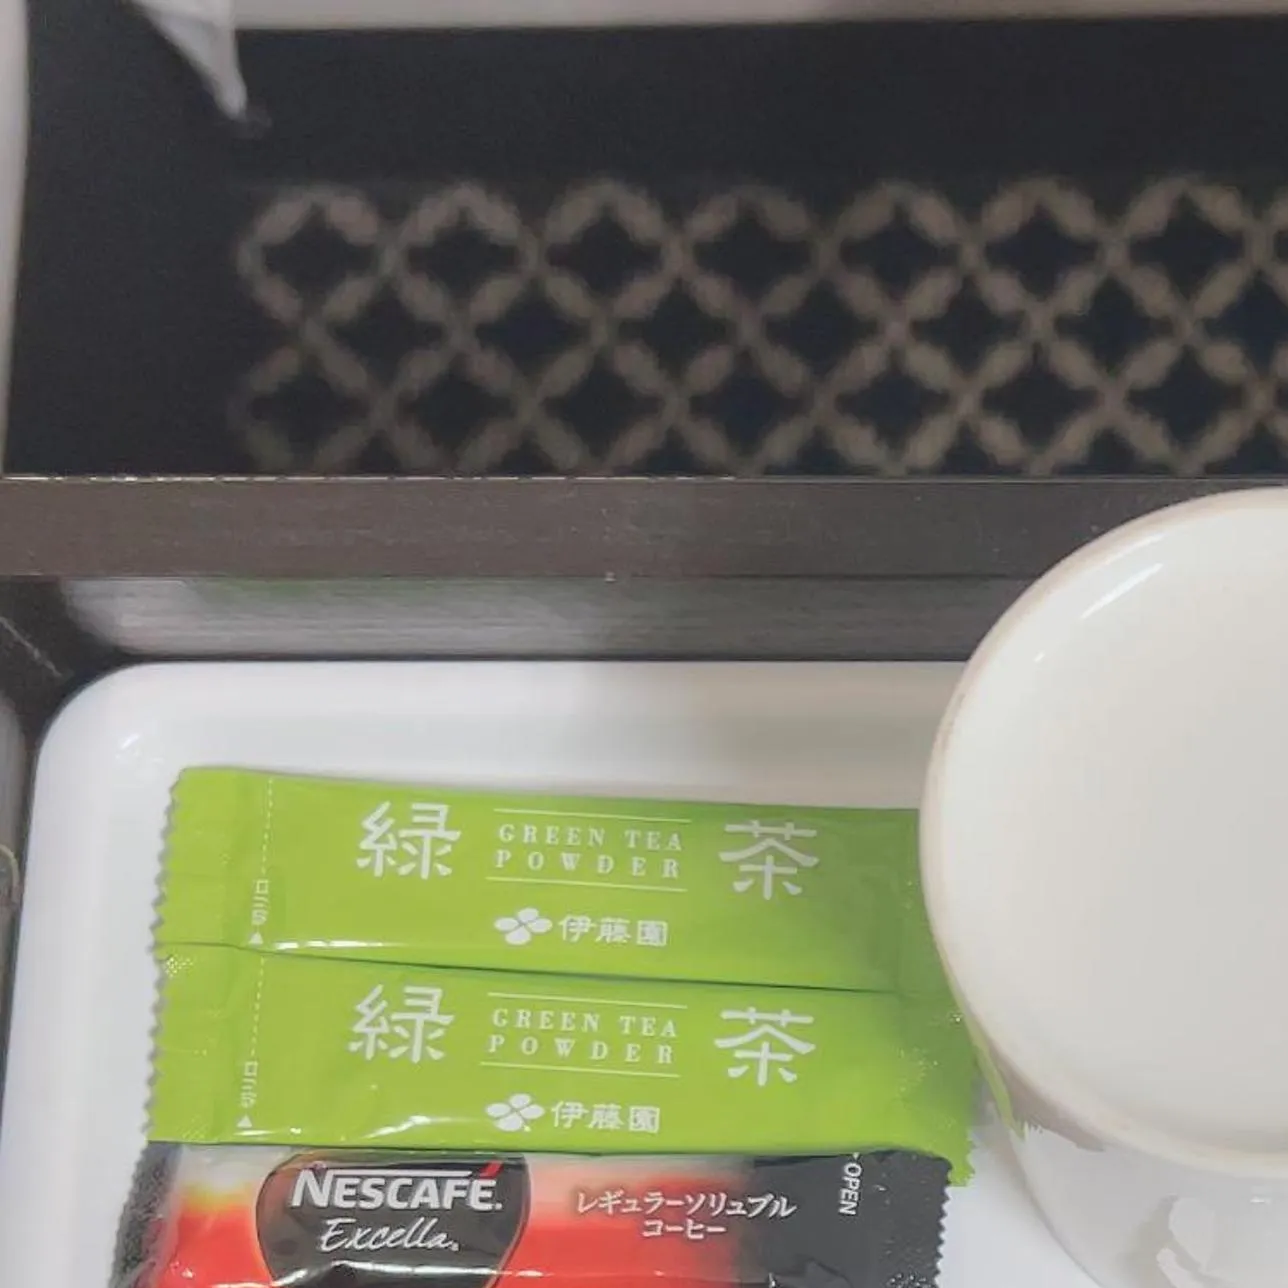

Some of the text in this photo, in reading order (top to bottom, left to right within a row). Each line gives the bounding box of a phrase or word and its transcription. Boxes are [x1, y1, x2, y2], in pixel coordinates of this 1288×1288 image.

[356, 801, 462, 880] 緑
[498, 824, 683, 852] GREEN TEA
[495, 850, 681, 878] POWDER
[718, 819, 820, 901] 茶
[558, 914, 669, 948] 伊藤園
[347, 984, 455, 1064] 緑
[491, 1009, 678, 1037] GREEN TEA
[487, 1035, 675, 1064] POWDER
[714, 1006, 817, 1087] 茶
[549, 1099, 661, 1134] 伊藤園
[839, 1162, 862, 1215] OPEN
[320, 1217, 452, 1253] Excella
[641, 1219, 727, 1240] コーヒー
